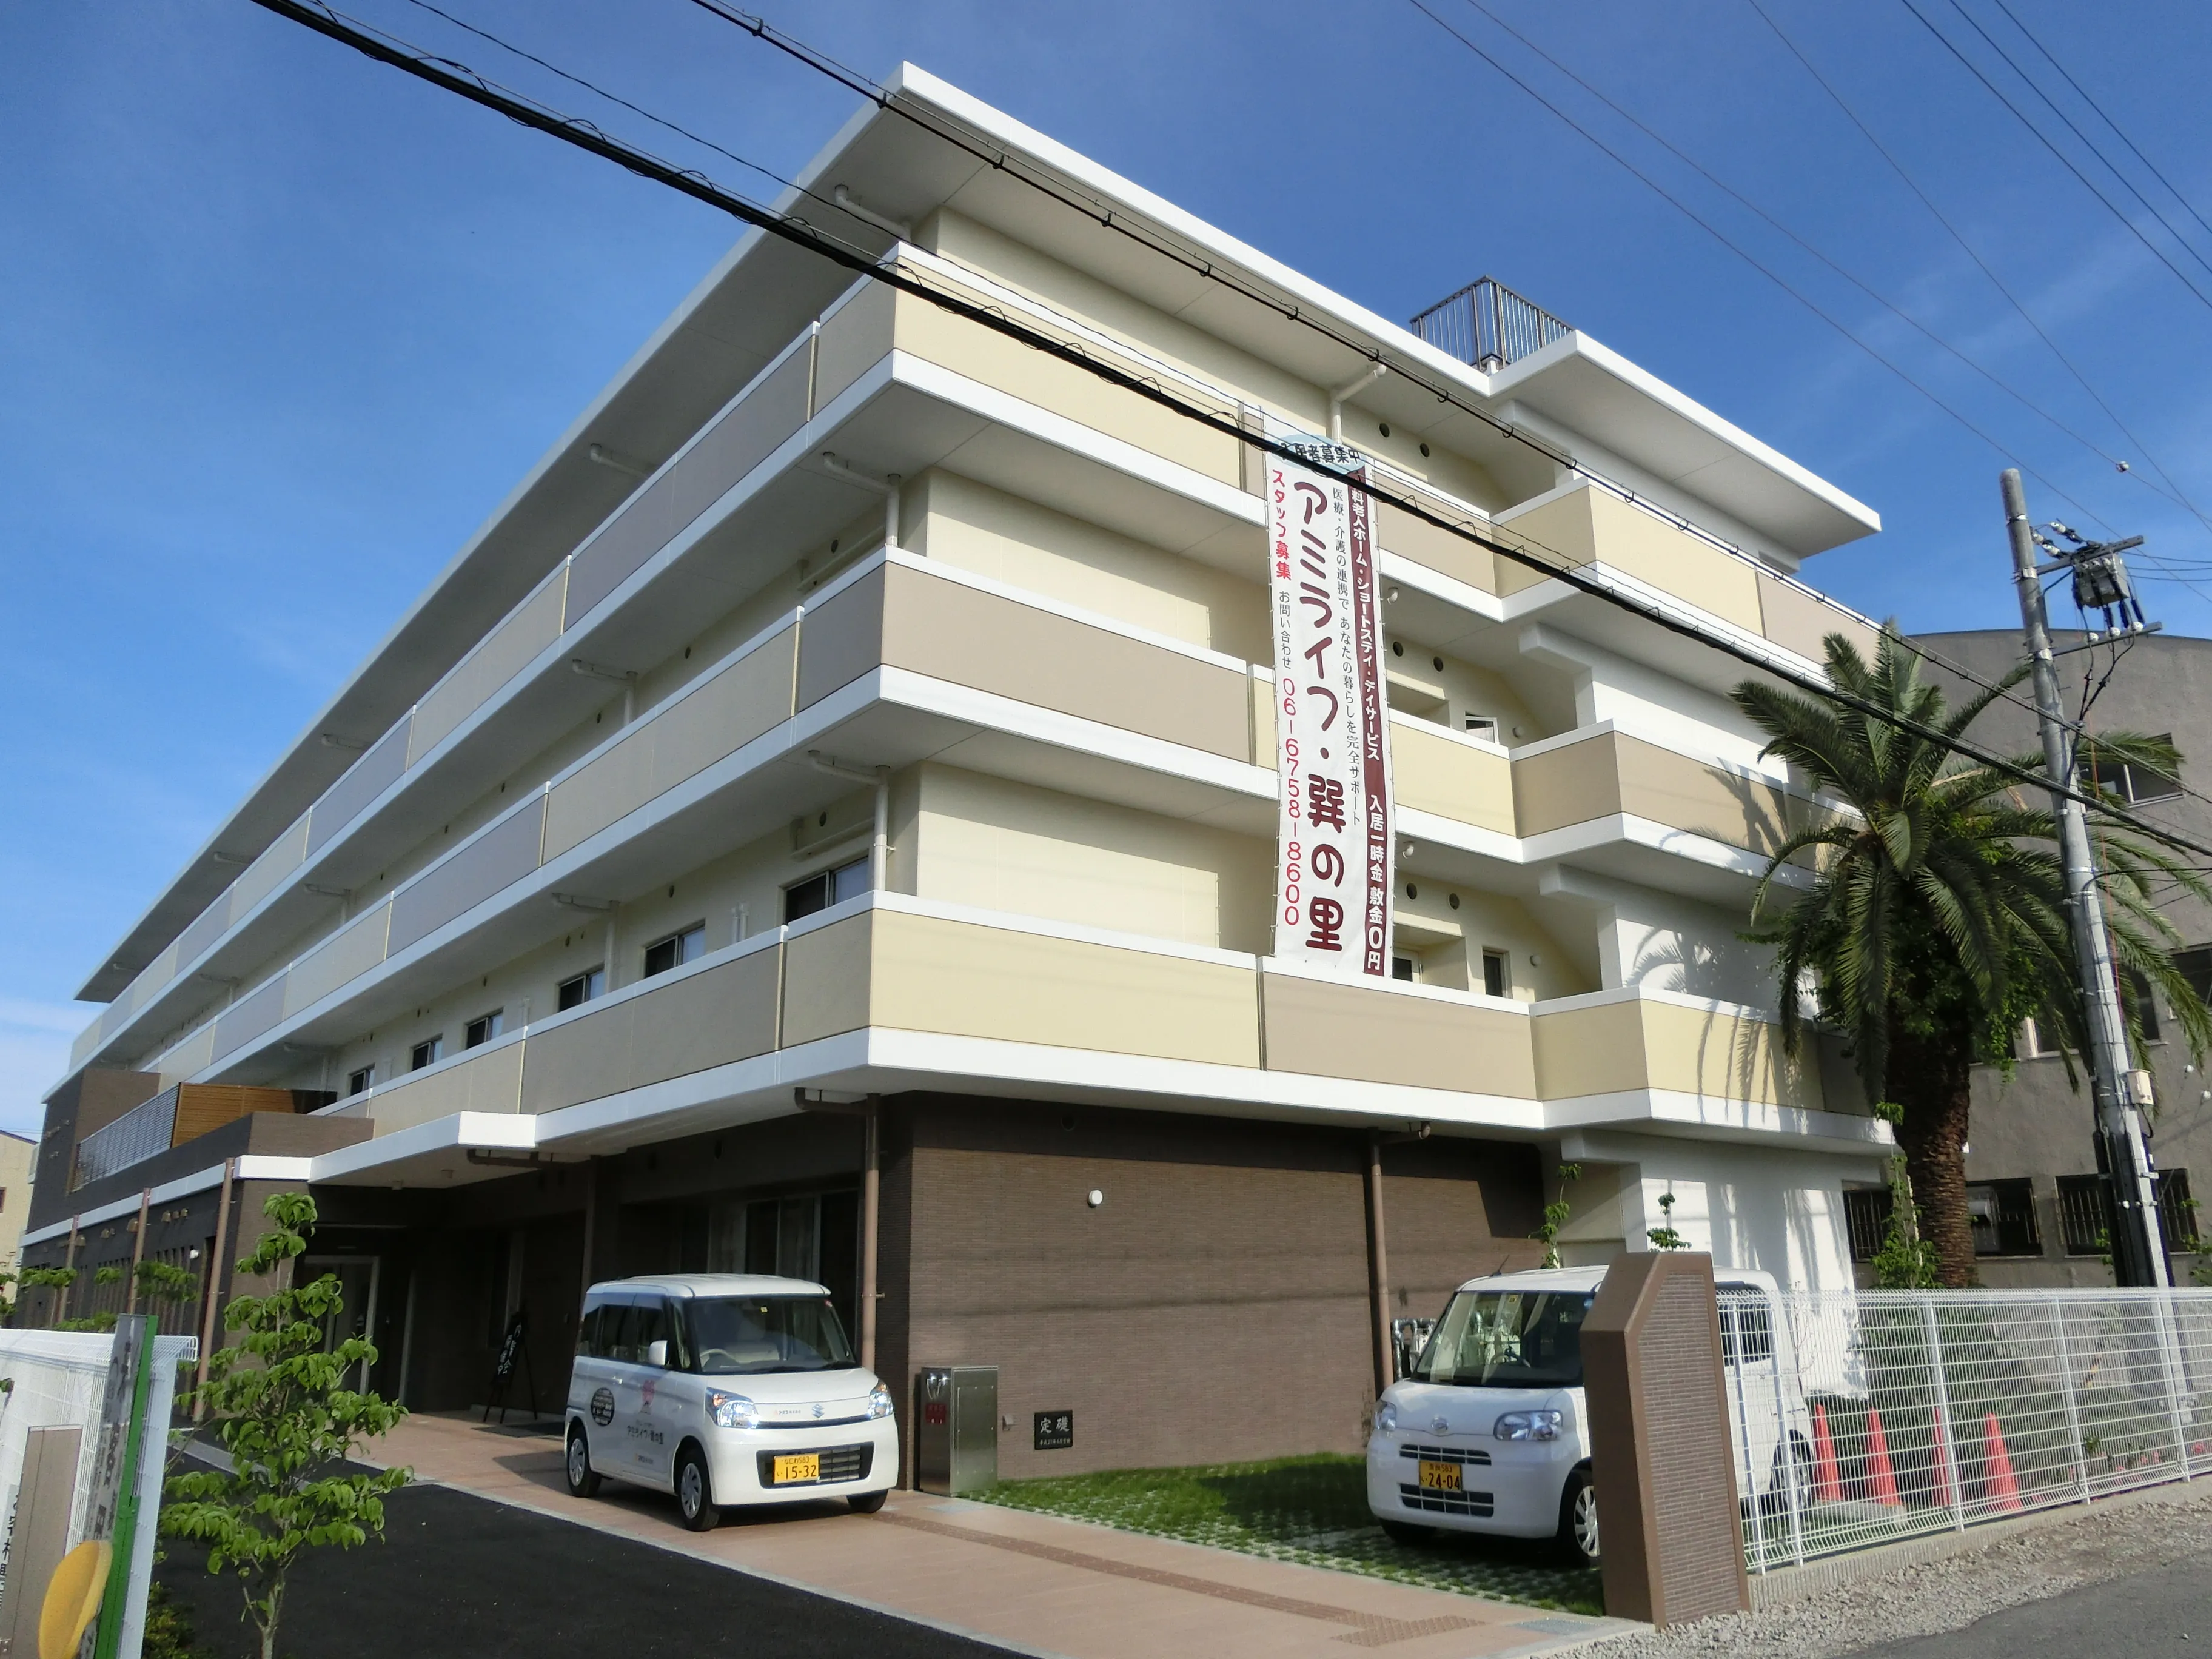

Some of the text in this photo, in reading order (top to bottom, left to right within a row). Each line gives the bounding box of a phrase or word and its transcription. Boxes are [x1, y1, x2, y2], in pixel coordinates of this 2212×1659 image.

[1272, 469, 1292, 581] スタッフ募集
[1279, 591, 1291, 669] お問い合わせ
[1293, 481, 1346, 952] アミライフ・巽の里
[1040, 1416, 1070, 1433] 定礎
[785, 1465, 817, 1479] 15-32
[1429, 1472, 1460, 1490] 24-04
